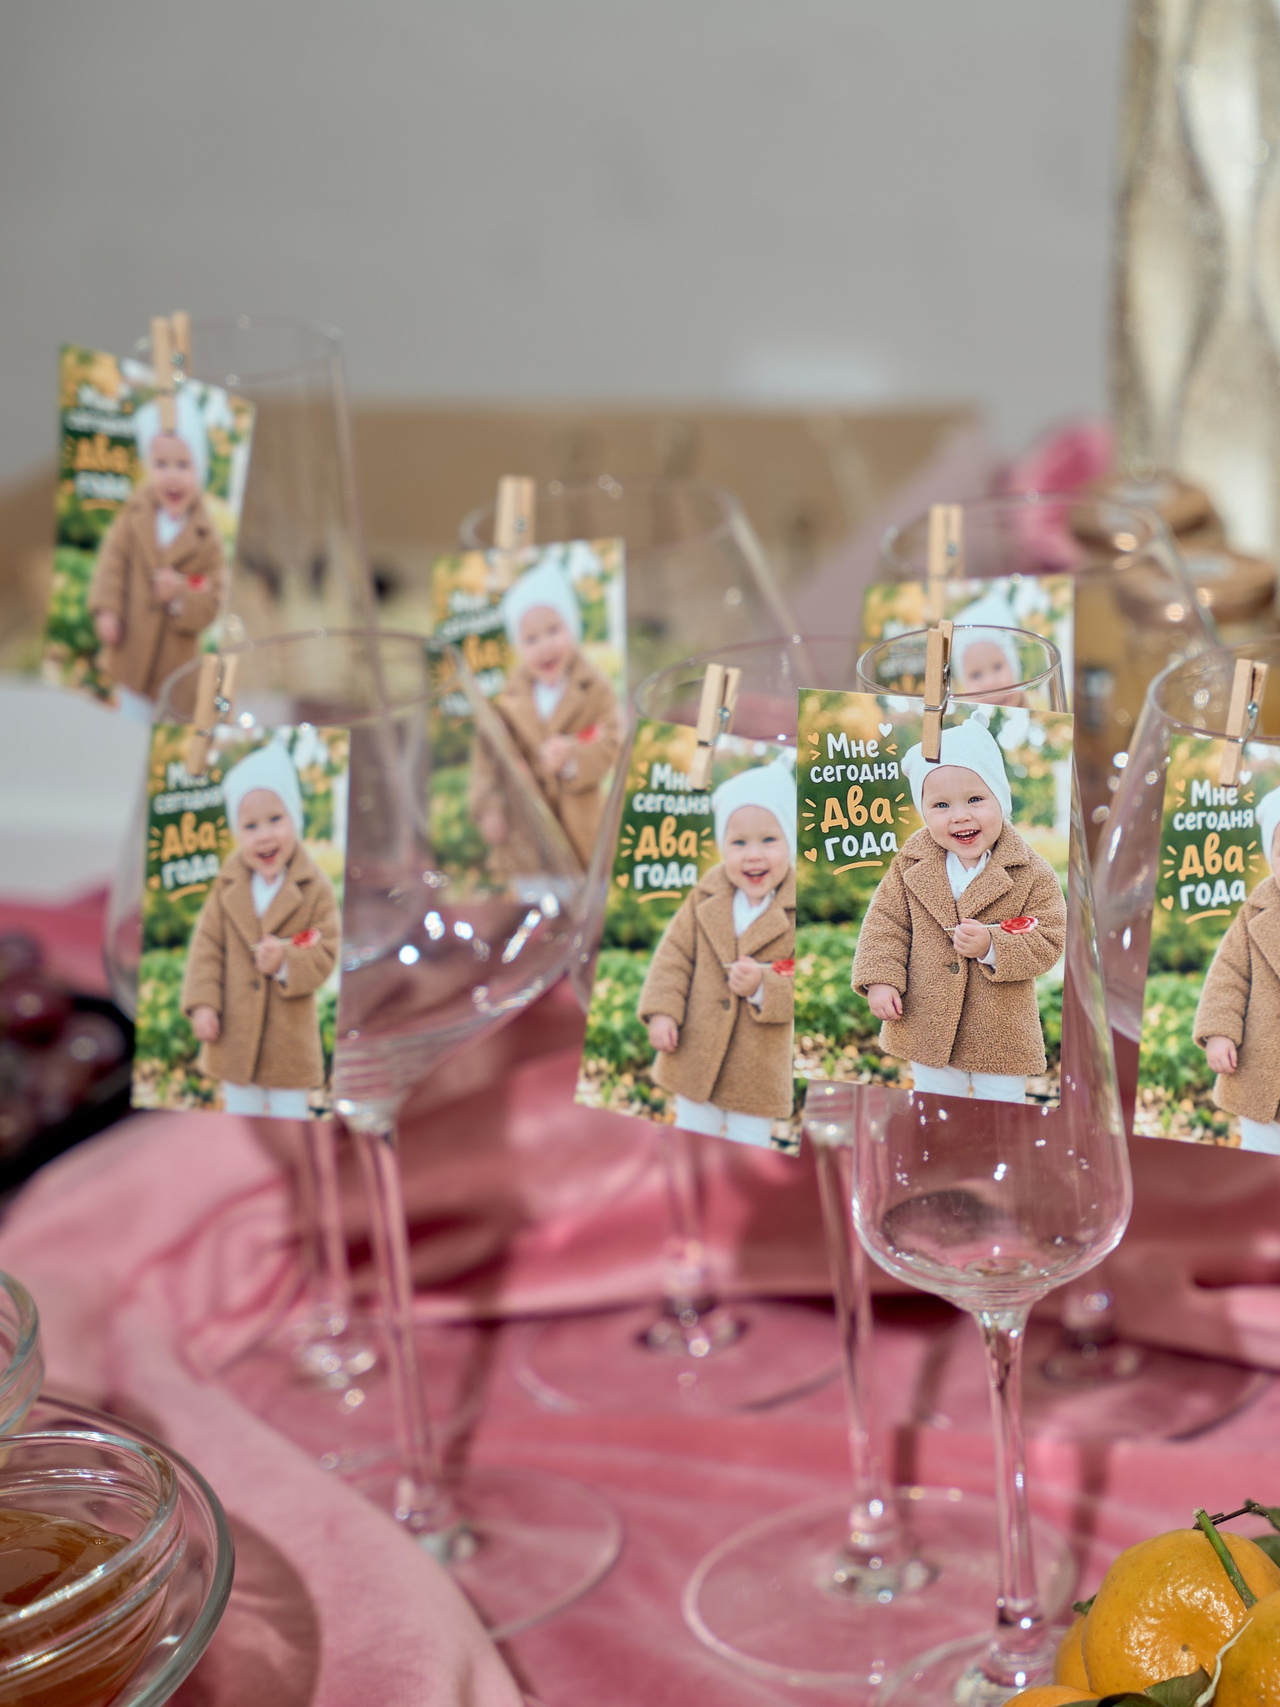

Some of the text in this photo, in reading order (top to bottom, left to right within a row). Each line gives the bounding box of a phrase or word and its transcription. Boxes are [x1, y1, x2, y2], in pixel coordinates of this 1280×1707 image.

[827, 732, 880, 760] Мне
[651, 762, 696, 792] Мн
[810, 761, 899, 784] сегодня
[632, 792, 711, 816] сегодня
[1191, 779, 1239, 807] Мне
[820, 785, 894, 833] Два
[1173, 809, 1254, 832] сегодня
[161, 811, 217, 862] Два
[634, 815, 698, 862] Два
[824, 831, 899, 861] года
[161, 853, 221, 890] года
[1178, 832, 1245, 881] Два
[633, 861, 698, 890] года
[1179, 879, 1247, 910] года
